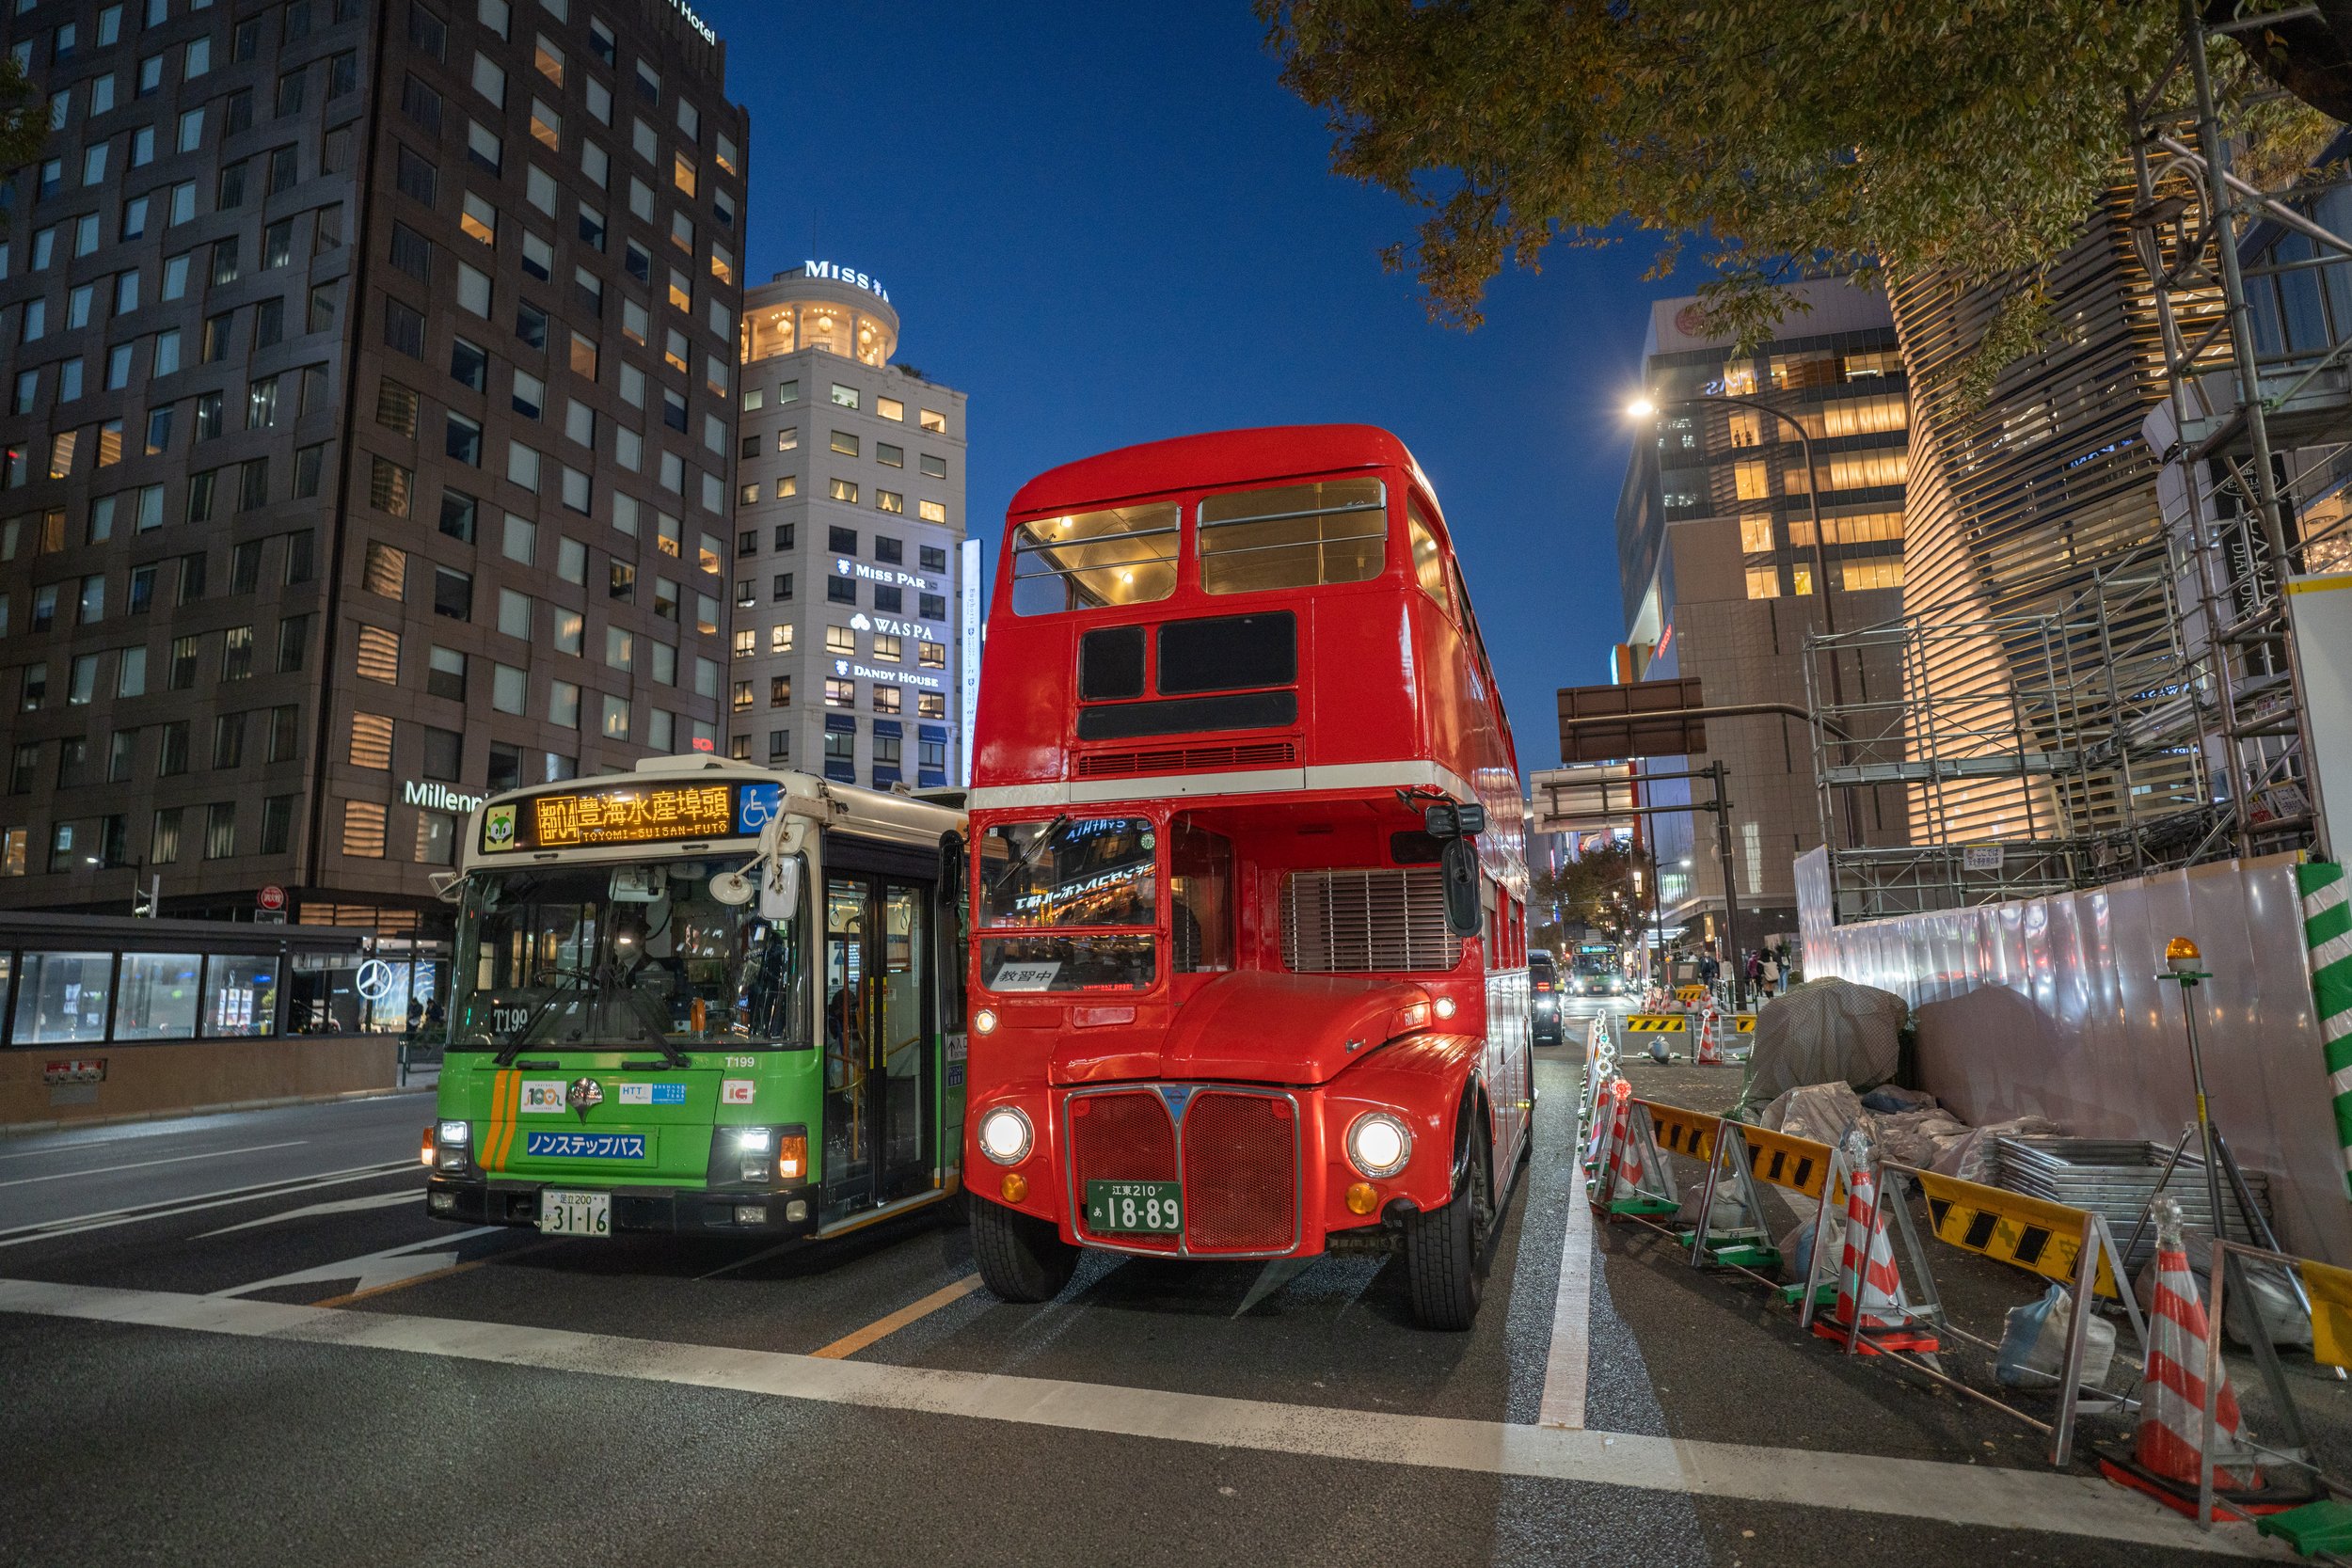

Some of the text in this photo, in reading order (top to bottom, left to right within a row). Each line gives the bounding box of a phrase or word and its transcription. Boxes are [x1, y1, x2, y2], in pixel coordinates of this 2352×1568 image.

[680, 2, 715, 46] Hotel
[873, 617, 933, 641] WASPA
[853, 665, 939, 688] DANDY HOUSE
[999, 970, 1052, 983] 教習中
[725, 1056, 755, 1068] T199
[529, 1134, 644, 1157] ノンステップバス
[553, 1205, 608, 1233] 31-16
[1093, 1197, 1180, 1229] あ 18-89
